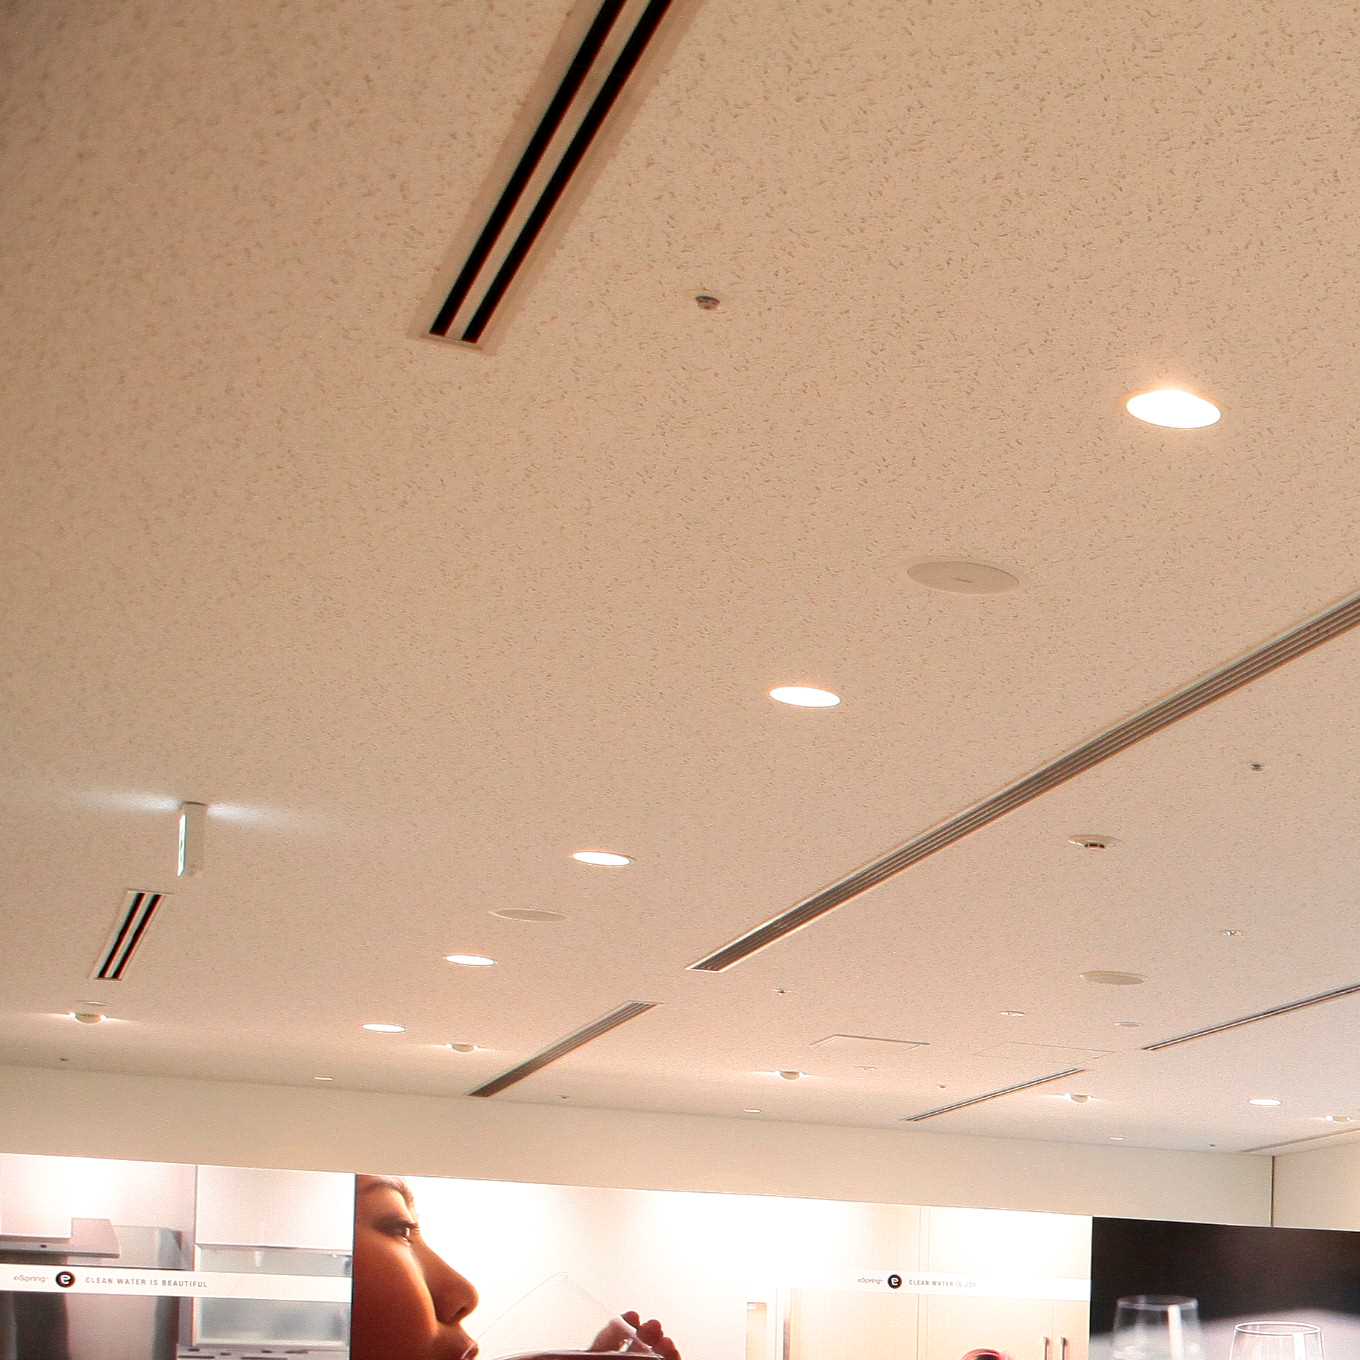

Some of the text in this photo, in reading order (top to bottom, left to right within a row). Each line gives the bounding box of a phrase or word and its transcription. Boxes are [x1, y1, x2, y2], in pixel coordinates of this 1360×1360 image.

[85, 1276, 113, 1285] CLEAN
[117, 1277, 146, 1286] WATER
[150, 1279, 158, 1287] IS
[162, 1279, 208, 1288] BEAUTIFUL
